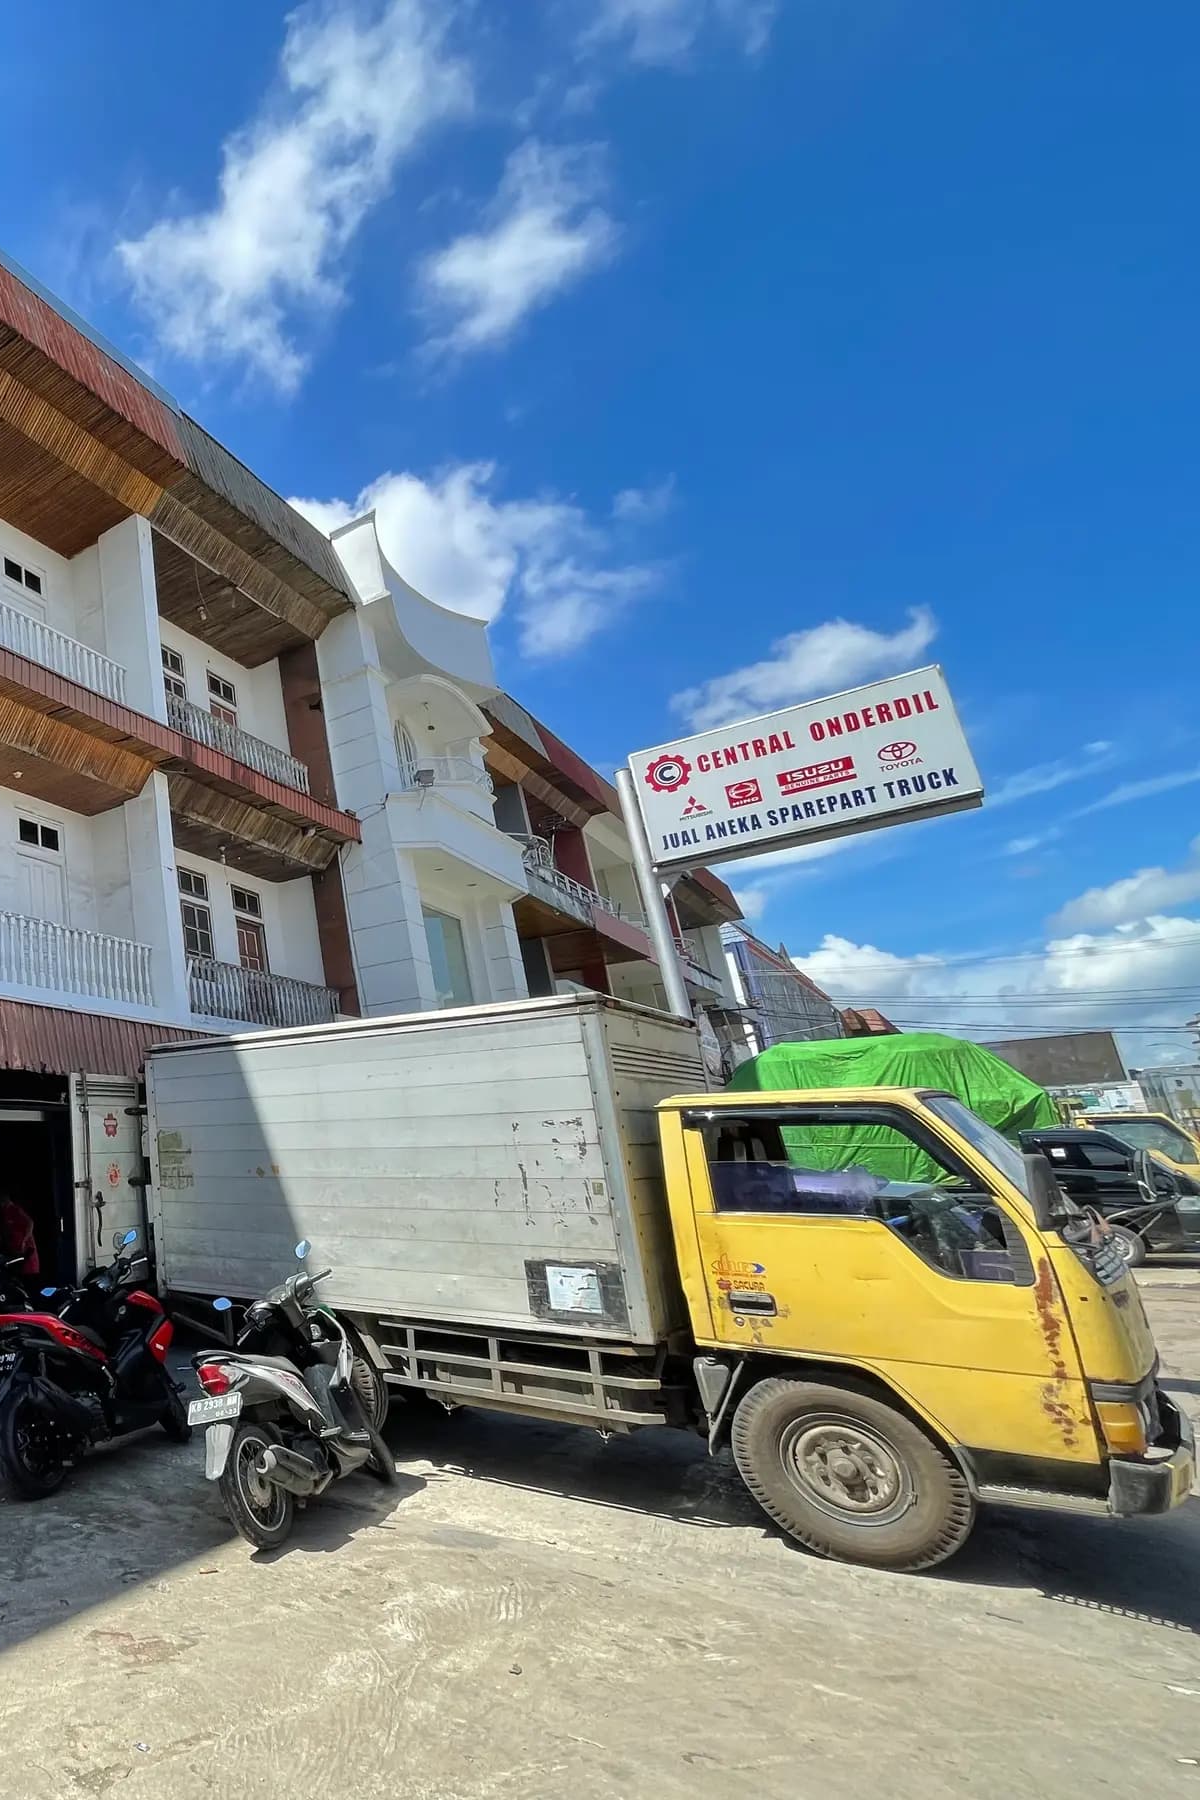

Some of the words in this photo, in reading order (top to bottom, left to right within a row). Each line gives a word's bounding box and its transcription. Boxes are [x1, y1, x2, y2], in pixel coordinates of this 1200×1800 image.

[696, 731, 796, 774] CENTRAL
[809, 690, 940, 742] ONDERDIL
[785, 763, 845, 782] ISUZU
[879, 756, 924, 773] TOYOTA
[784, 778, 820, 790] GENUINE
[822, 770, 851, 782] PARTS
[662, 825, 701, 851] JUAL
[705, 813, 763, 840] ANEKA
[768, 785, 878, 827] SPAREPART
[882, 767, 959, 800] TRUCK
[732, 796, 760, 806] HINO
[679, 809, 713, 822] MITSUBISHI
